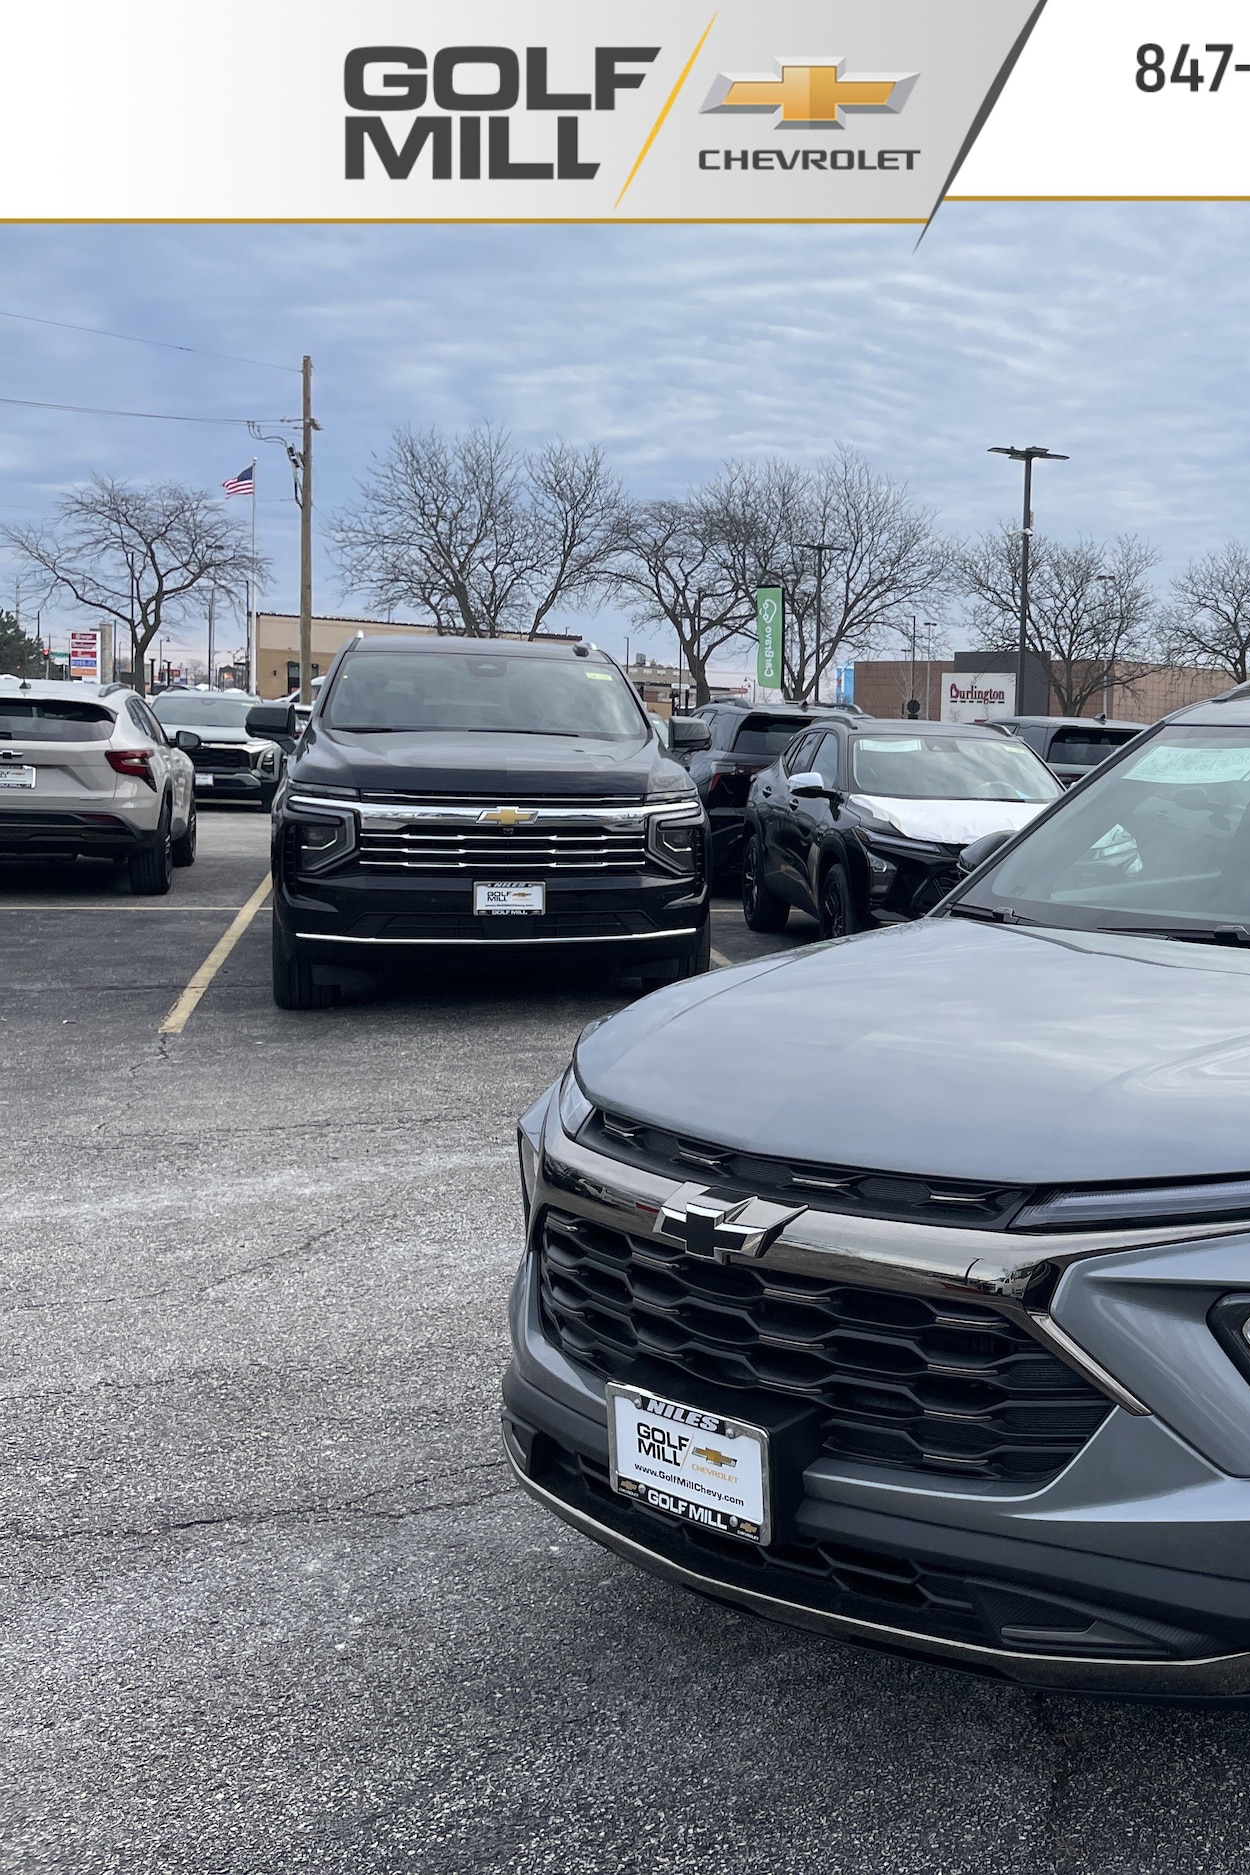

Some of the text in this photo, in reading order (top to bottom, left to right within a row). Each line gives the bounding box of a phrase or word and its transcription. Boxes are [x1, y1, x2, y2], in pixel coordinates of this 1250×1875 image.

[950, 683, 1005, 704] Burlington
[647, 1400, 719, 1431] NILES
[637, 1422, 689, 1451] GOLF
[637, 1438, 681, 1467] MILL
[634, 1463, 744, 1506] www.GolfMillChevy.com
[692, 1463, 739, 1484] CHEVROLET
[647, 1489, 727, 1530] GOLF MILL
